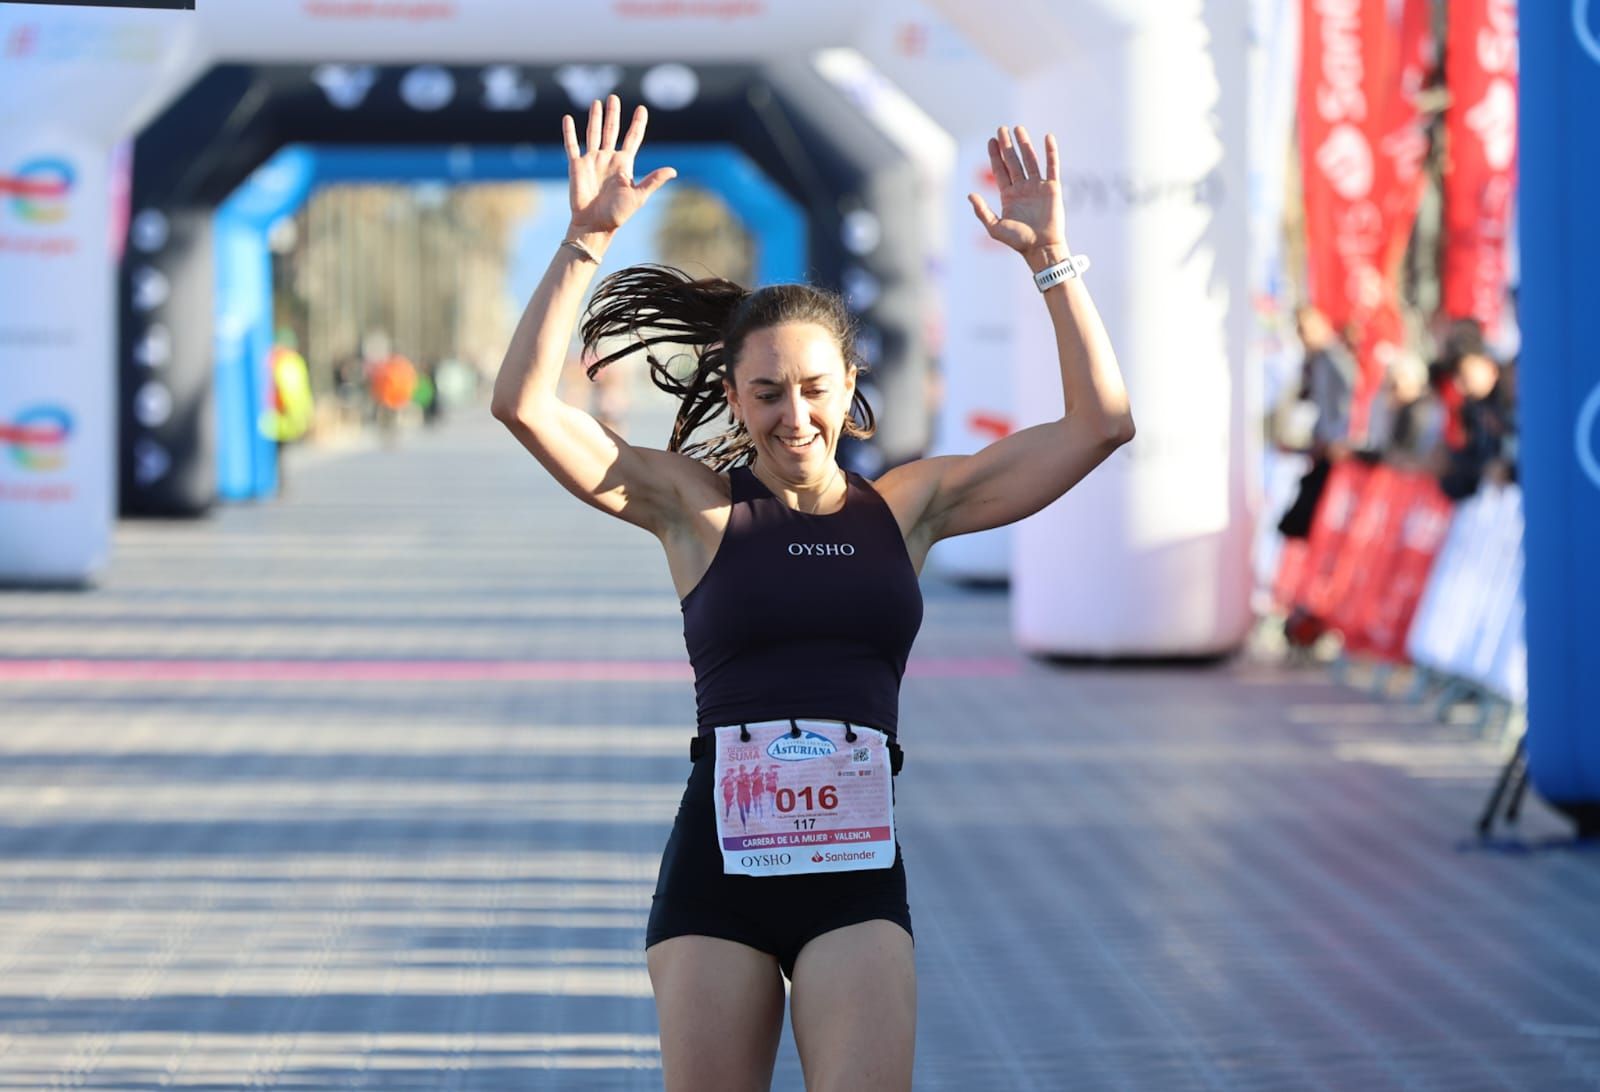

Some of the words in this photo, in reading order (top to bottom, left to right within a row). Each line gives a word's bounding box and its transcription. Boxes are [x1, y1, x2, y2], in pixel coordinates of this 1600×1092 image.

[311, 63, 700, 112] VOLVO
[788, 543, 855, 556] OYSHO
[772, 743, 833, 756] ASTURIANA
[776, 785, 838, 813] 016
[793, 818, 816, 830] 117
[742, 838, 775, 848] CARRERA
[777, 836, 788, 845] DE
[789, 835, 800, 844] LA
[801, 833, 828, 843] MUJER
[834, 831, 871, 841] VALENCIA
[741, 853, 791, 867] OYSHO
[825, 850, 876, 862] Santander
